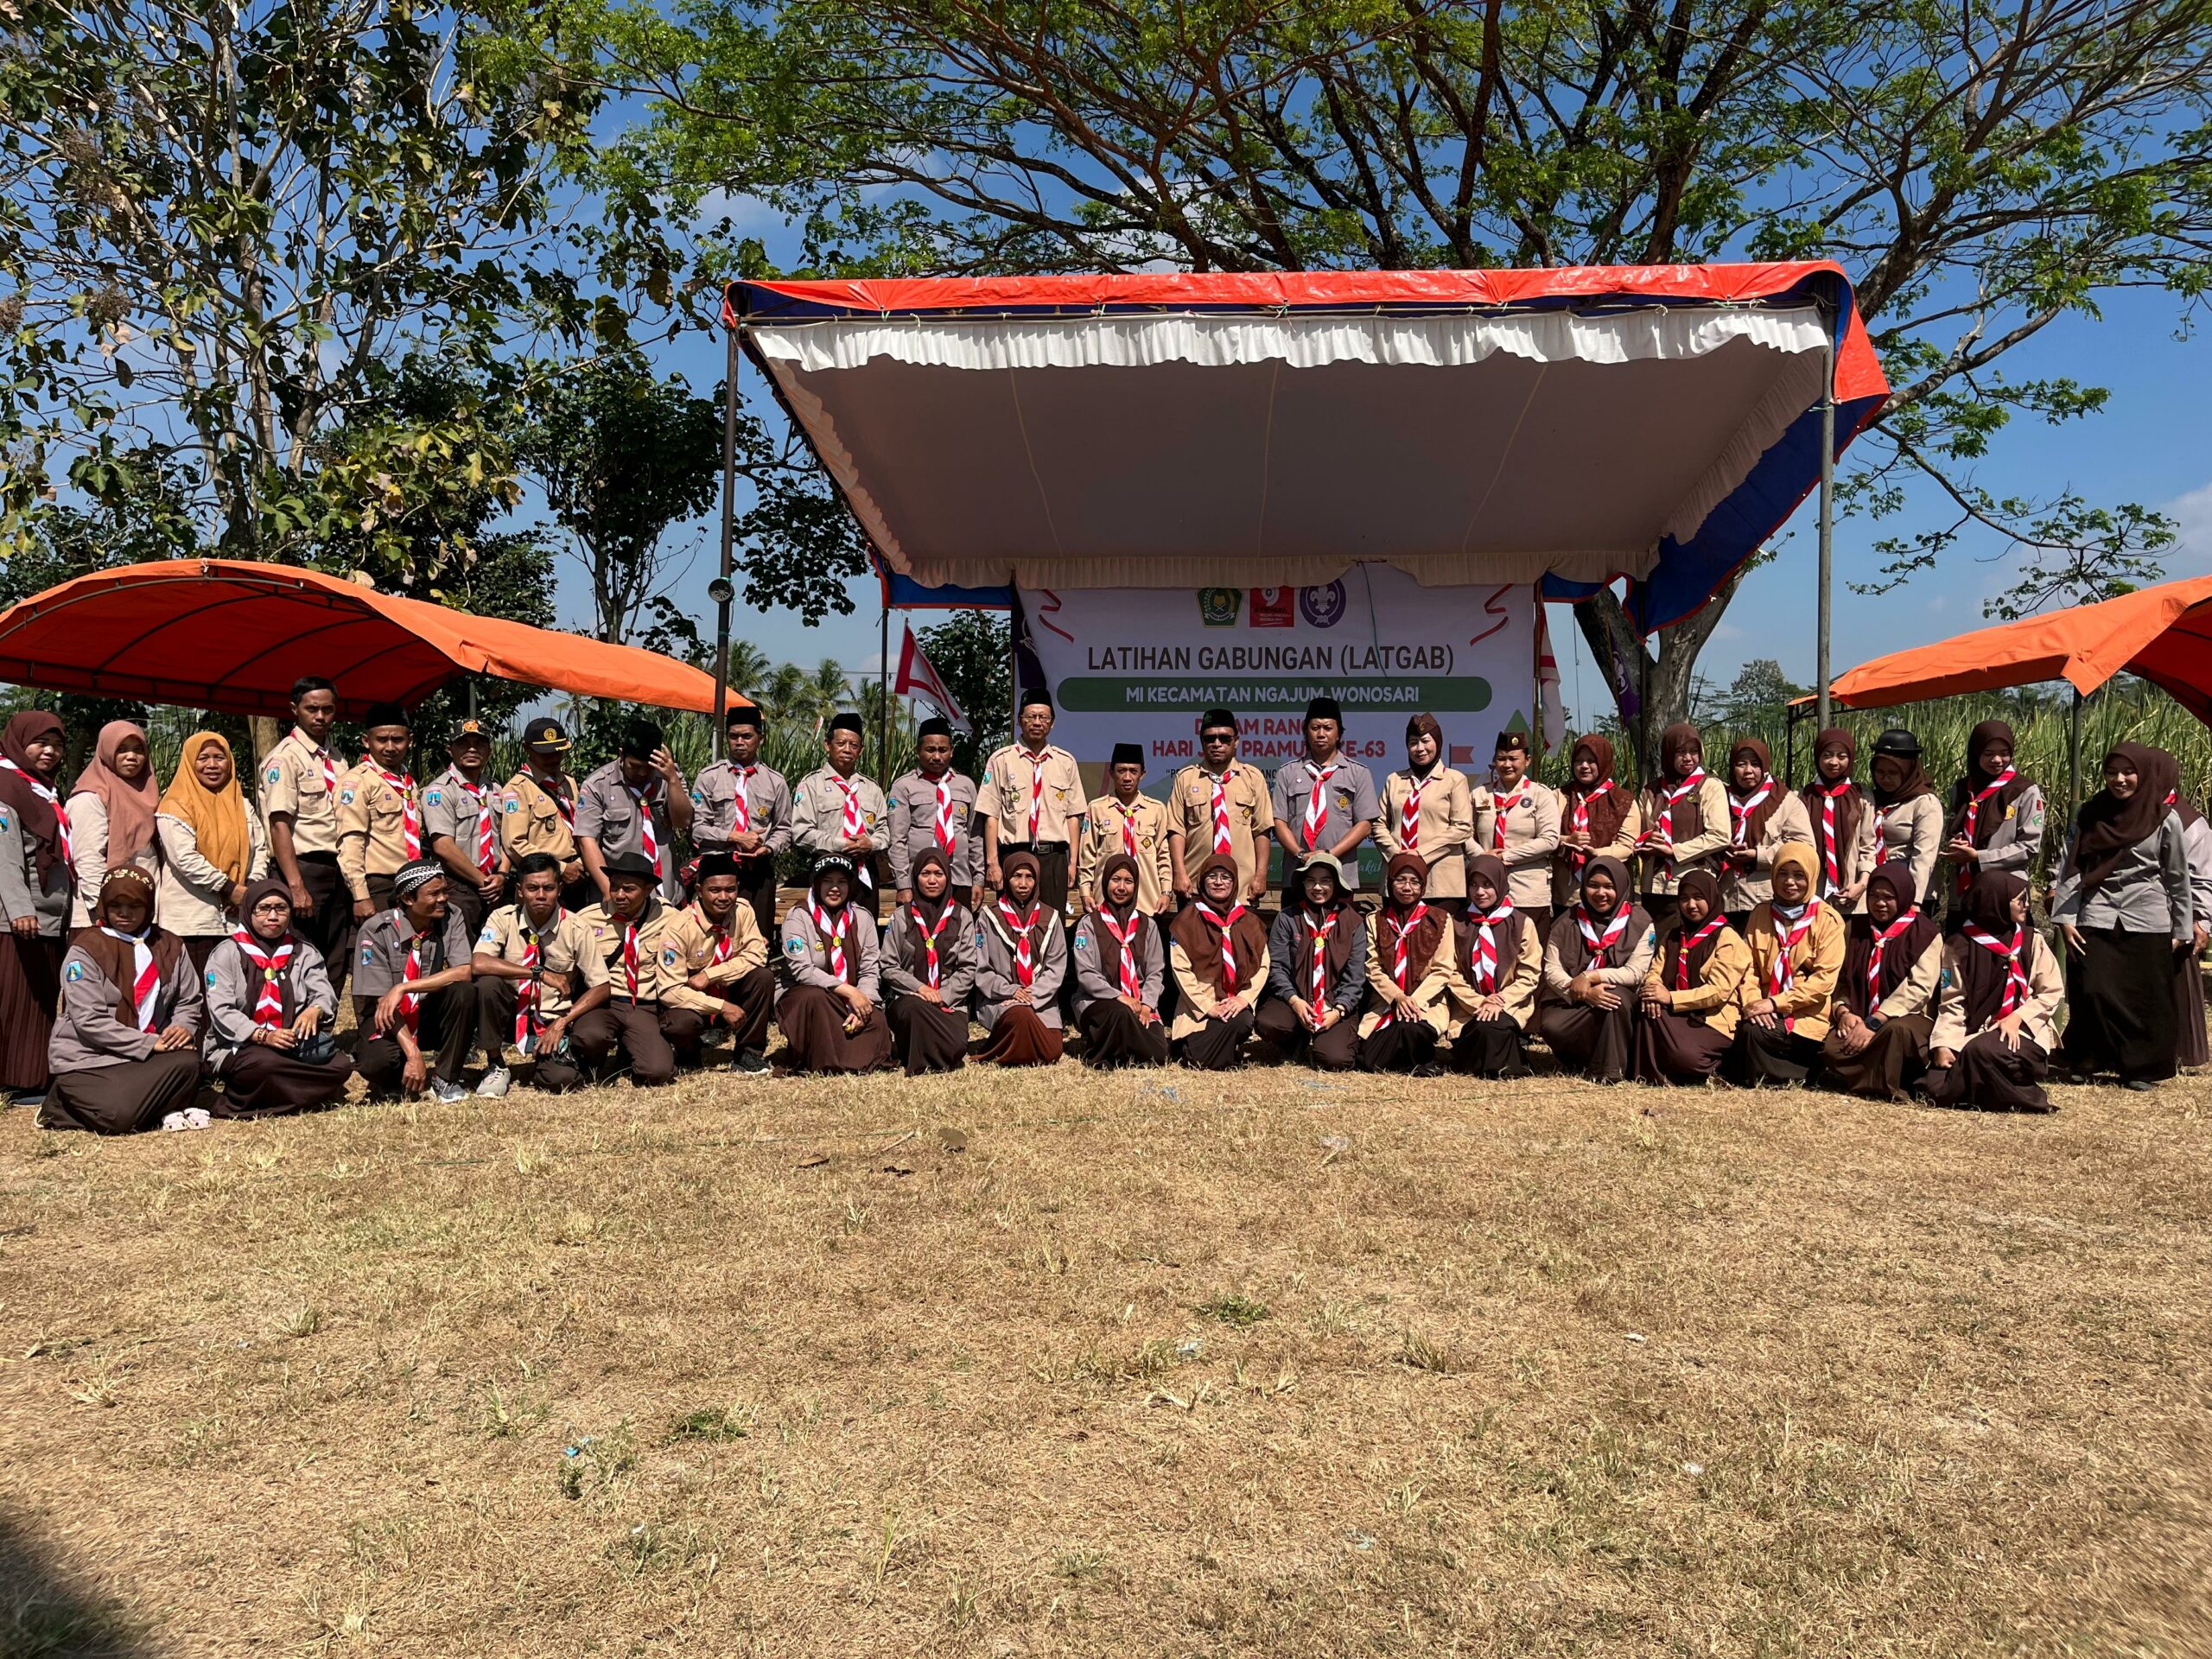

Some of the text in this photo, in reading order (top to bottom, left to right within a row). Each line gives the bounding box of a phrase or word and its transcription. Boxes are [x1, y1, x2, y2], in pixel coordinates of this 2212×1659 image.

[1088, 644, 1454, 676] LATIHAN GABUNGAN (LATGAB)
[1126, 686, 1420, 702] MI KECAMATAN NGAJUM-WONOSARI
[1152, 740, 1193, 757] HARI
